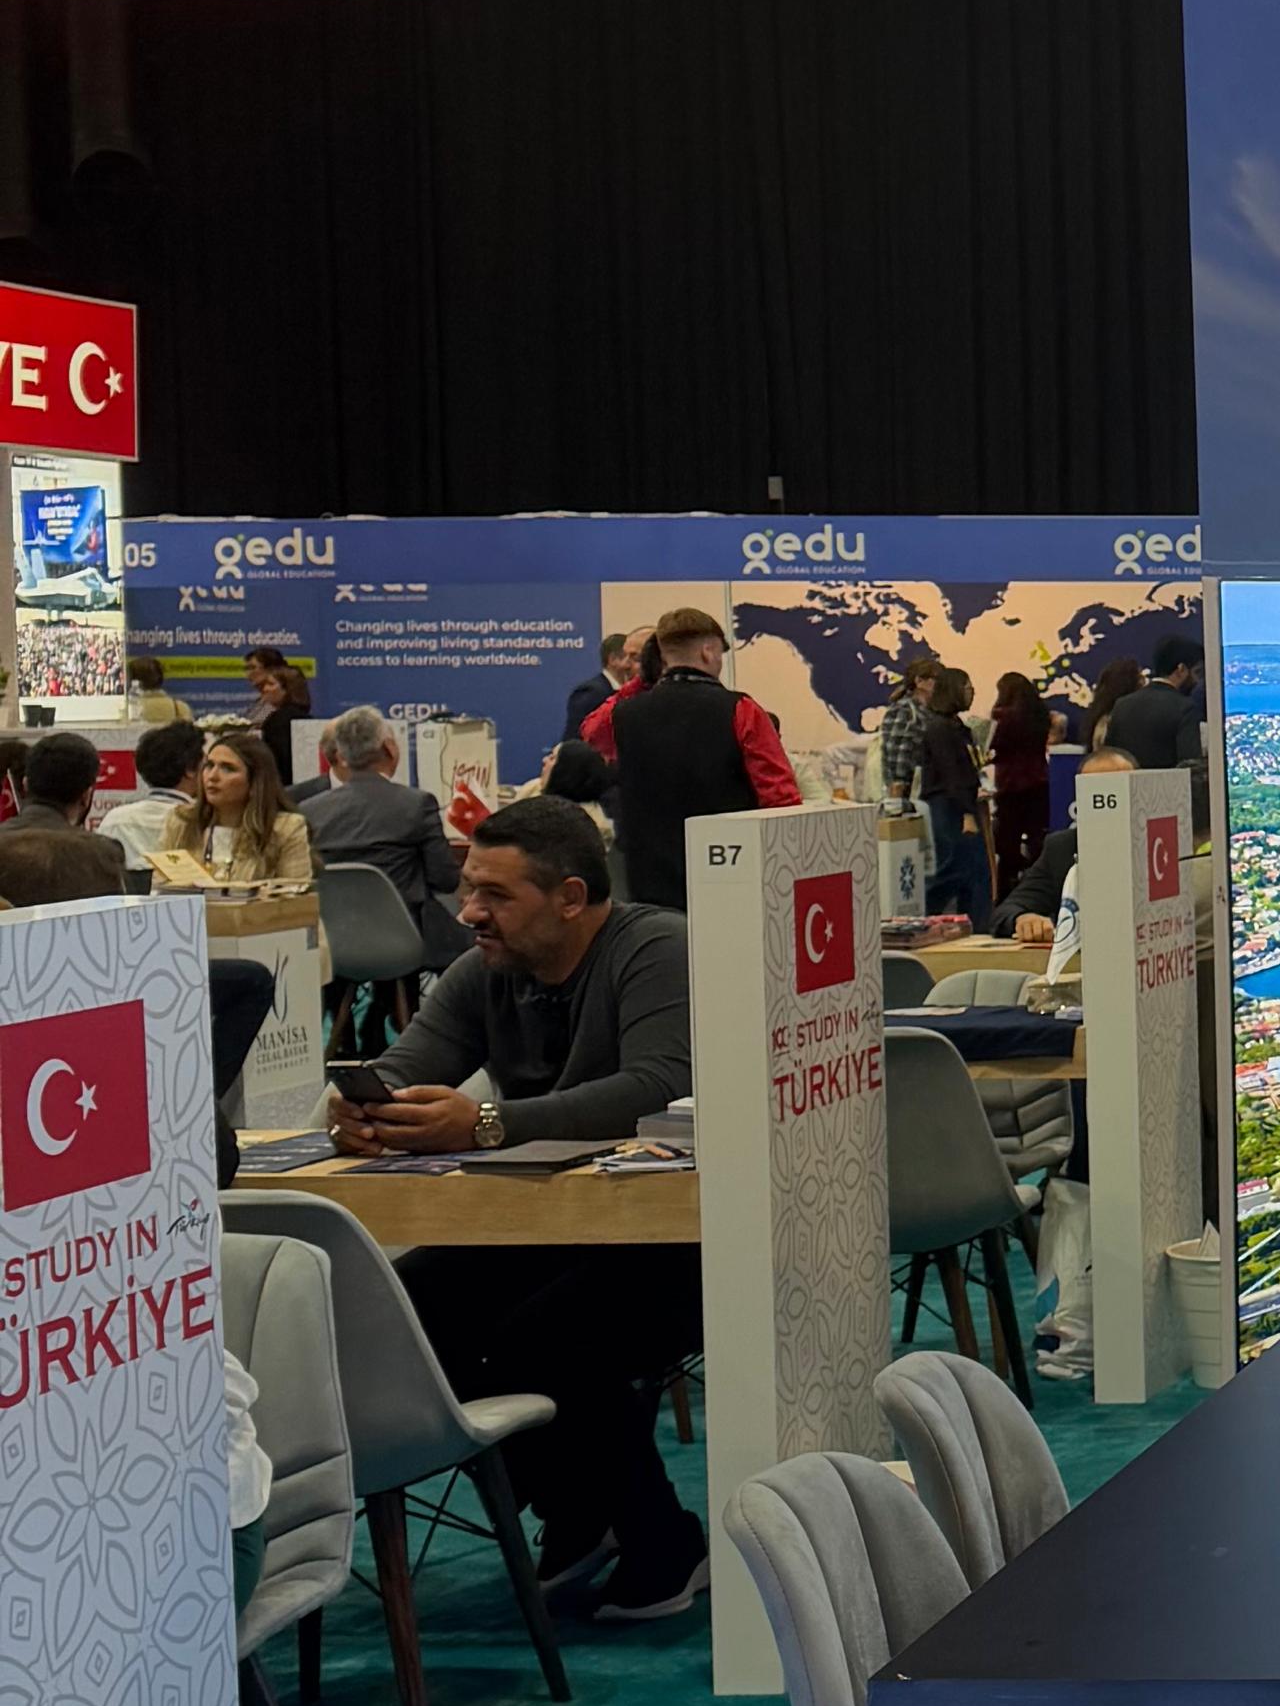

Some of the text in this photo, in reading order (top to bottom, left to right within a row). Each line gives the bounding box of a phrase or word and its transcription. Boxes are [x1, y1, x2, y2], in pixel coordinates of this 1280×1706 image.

[125, 542, 157, 568] 05
[214, 527, 335, 580] gedu
[742, 523, 865, 575] gedu
[335, 618, 574, 635] Changing lives through education
[336, 635, 585, 652] and improving living standards and
[336, 652, 542, 669] access to learning worldwide.
[1092, 793, 1117, 810] B6
[708, 844, 742, 866] B7
[1137, 940, 1195, 994] TÜRKİYE
[796, 1011, 841, 1048] STUDY
[844, 1006, 858, 1035] IN
[772, 1043, 882, 1123] TÜRKİYE
[4, 1227, 118, 1298] STUDY
[126, 1214, 158, 1261] IN
